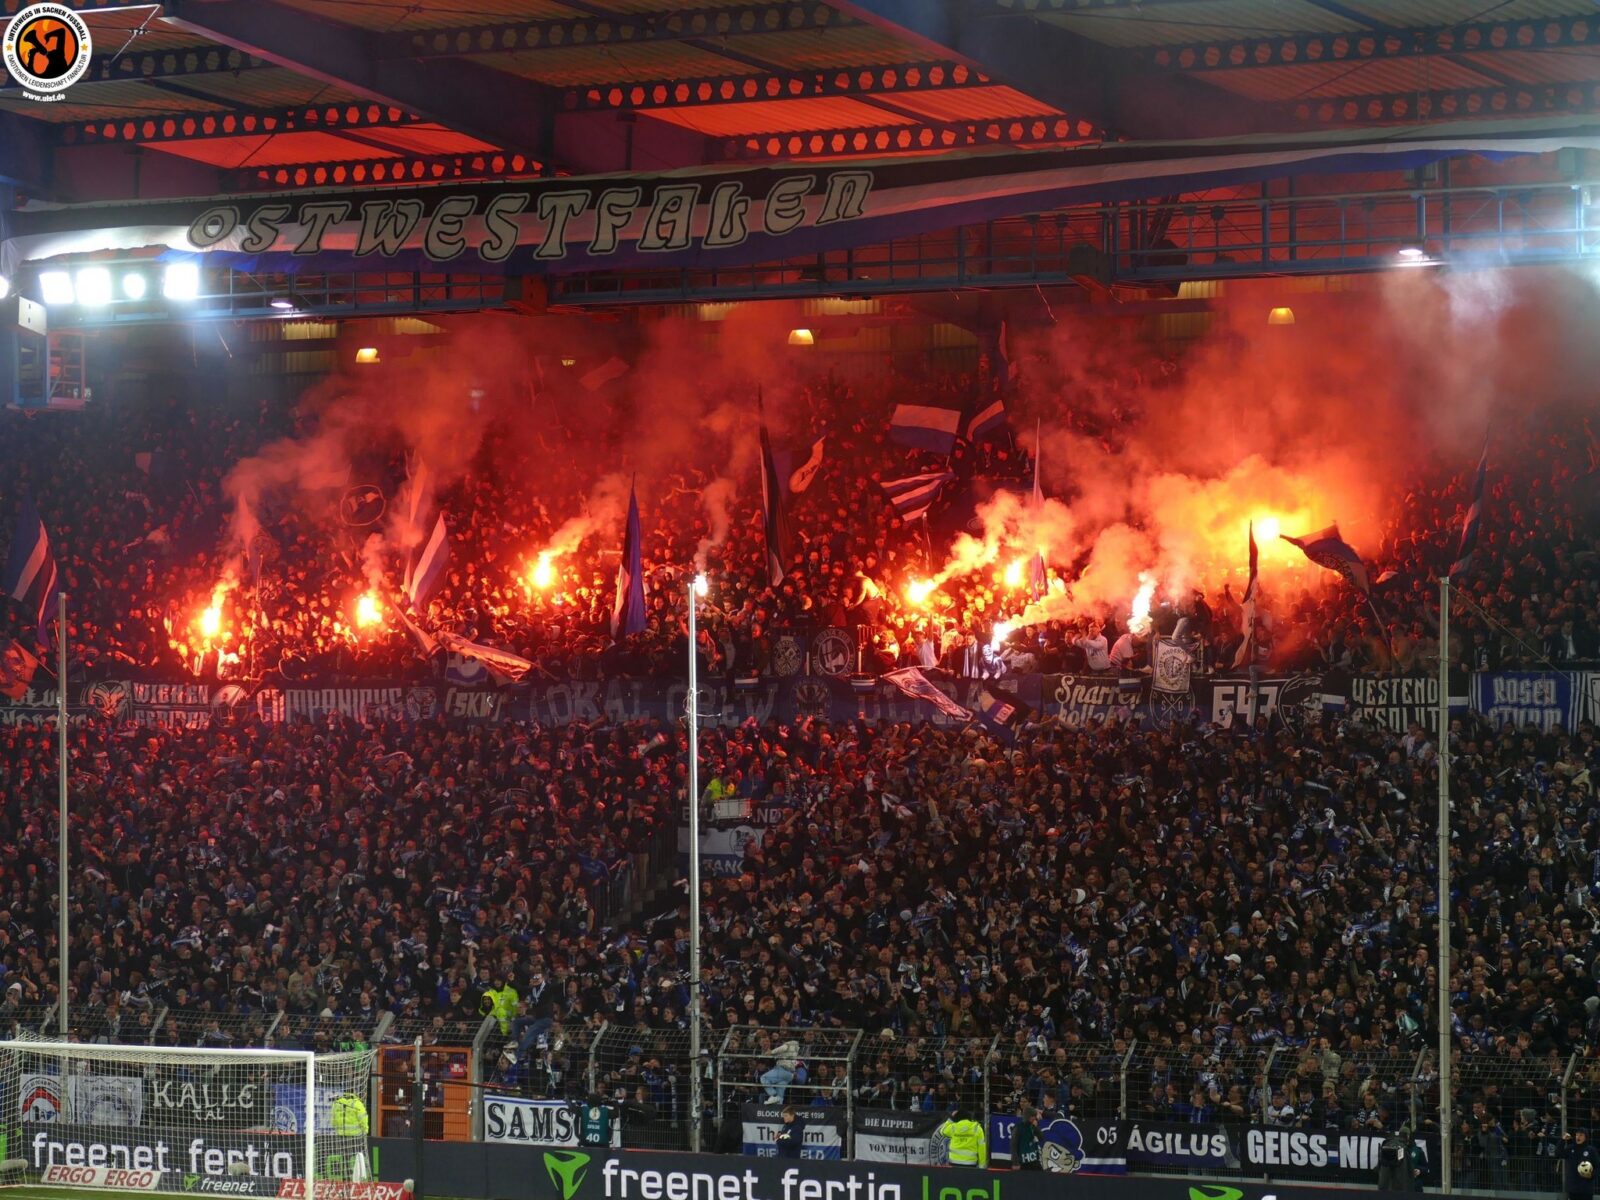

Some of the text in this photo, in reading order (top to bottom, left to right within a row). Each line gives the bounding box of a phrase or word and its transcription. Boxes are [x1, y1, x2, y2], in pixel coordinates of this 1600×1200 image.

[186, 169, 876, 262] OSTWESTFALEN
[152, 1081, 257, 1109] KALLE
[756, 1110, 779, 1118] BLOCK
[864, 1117, 914, 1129] DIE LIPPER
[585, 1132, 600, 1143] 40
[1096, 1126, 1118, 1145] 05
[1126, 1125, 1227, 1158] ÁGILUS
[869, 1143, 925, 1155] VON BLOCK 3
[46, 1165, 154, 1188] ERGO ERGO
[200, 1177, 256, 1193] freenet
